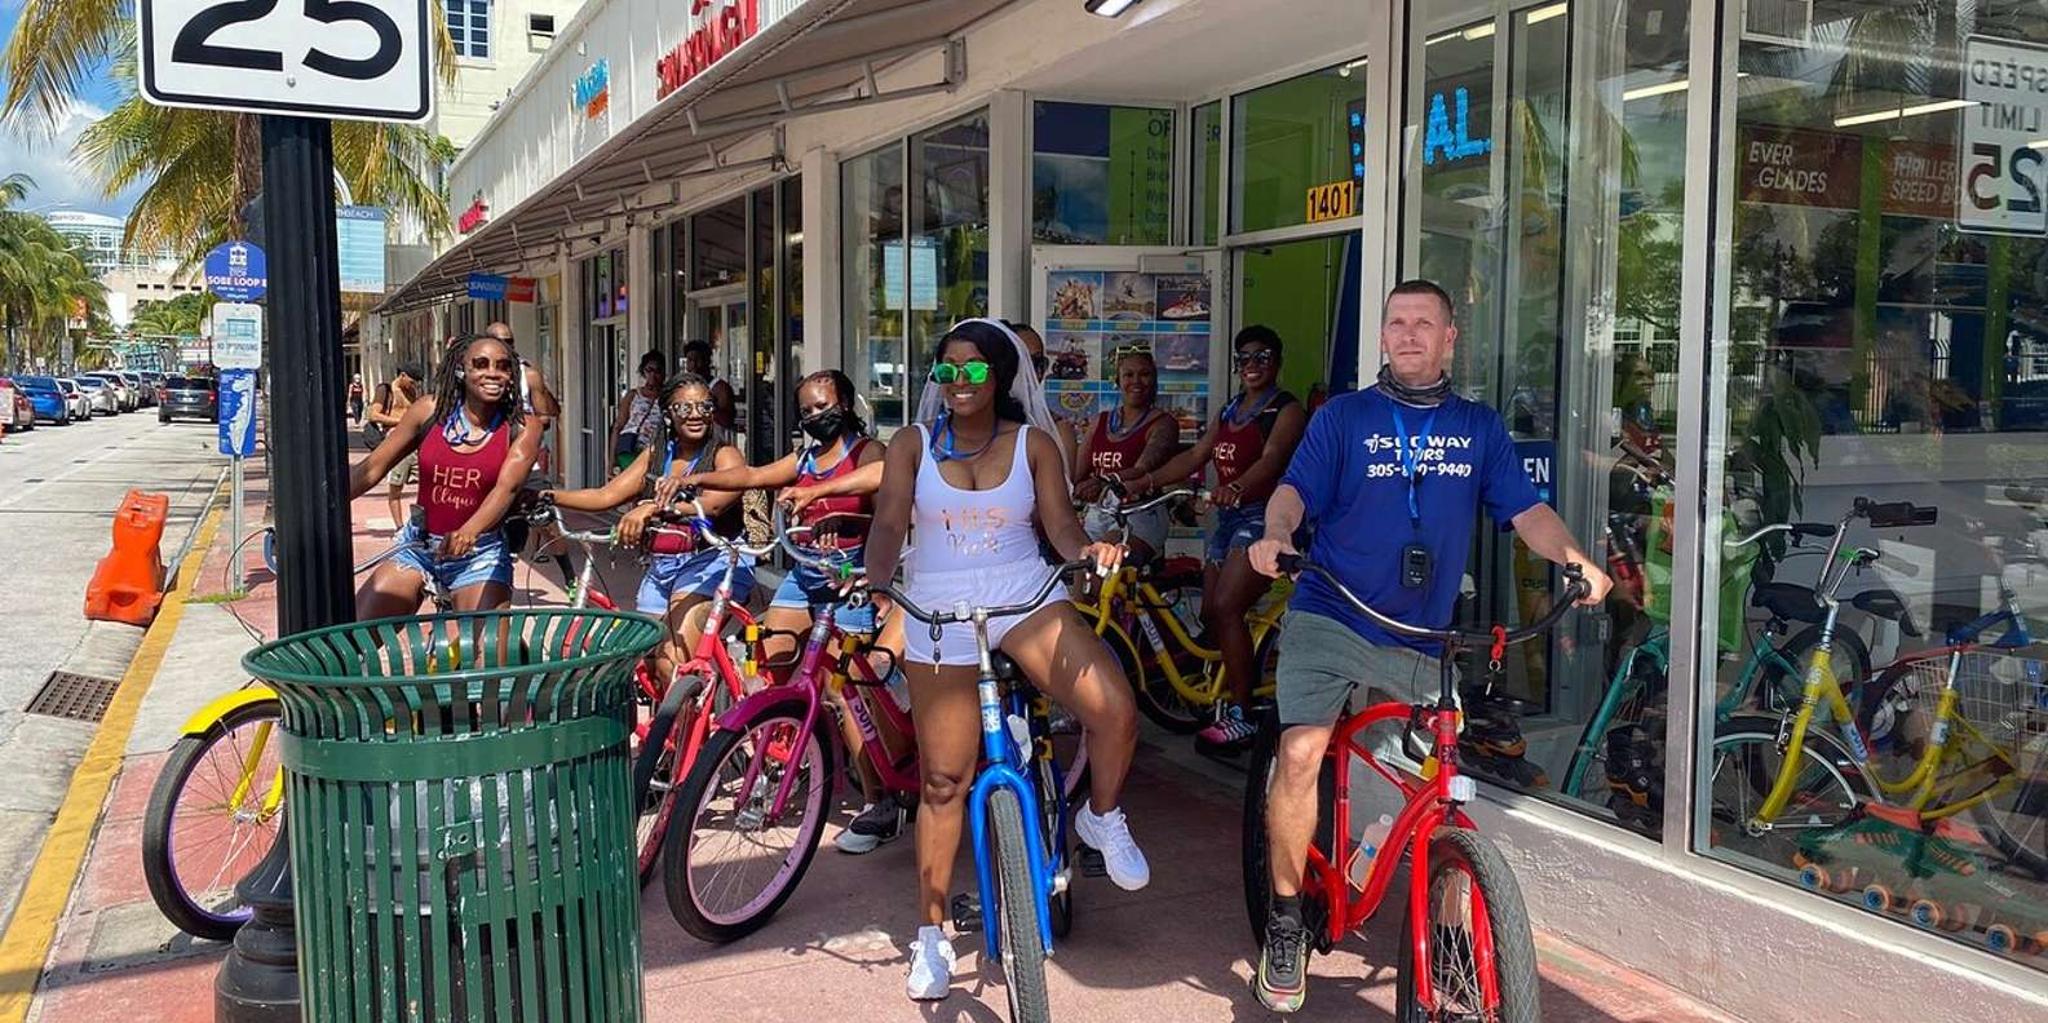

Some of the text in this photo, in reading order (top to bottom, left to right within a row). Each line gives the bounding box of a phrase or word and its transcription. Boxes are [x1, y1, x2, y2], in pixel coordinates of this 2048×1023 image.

[171, 0, 403, 80] 25
[1749, 141, 1793, 166] EVER
[1759, 167, 1828, 193] GLADES
[1893, 154, 1957, 181] THRILLER
[1309, 184, 1352, 220] 1401
[1890, 182, 1937, 201] SPEED
[234, 278, 260, 288] LOOP
[1092, 452, 1122, 468] HER
[1523, 457, 1549, 483] EN
[433, 464, 481, 489] HER
